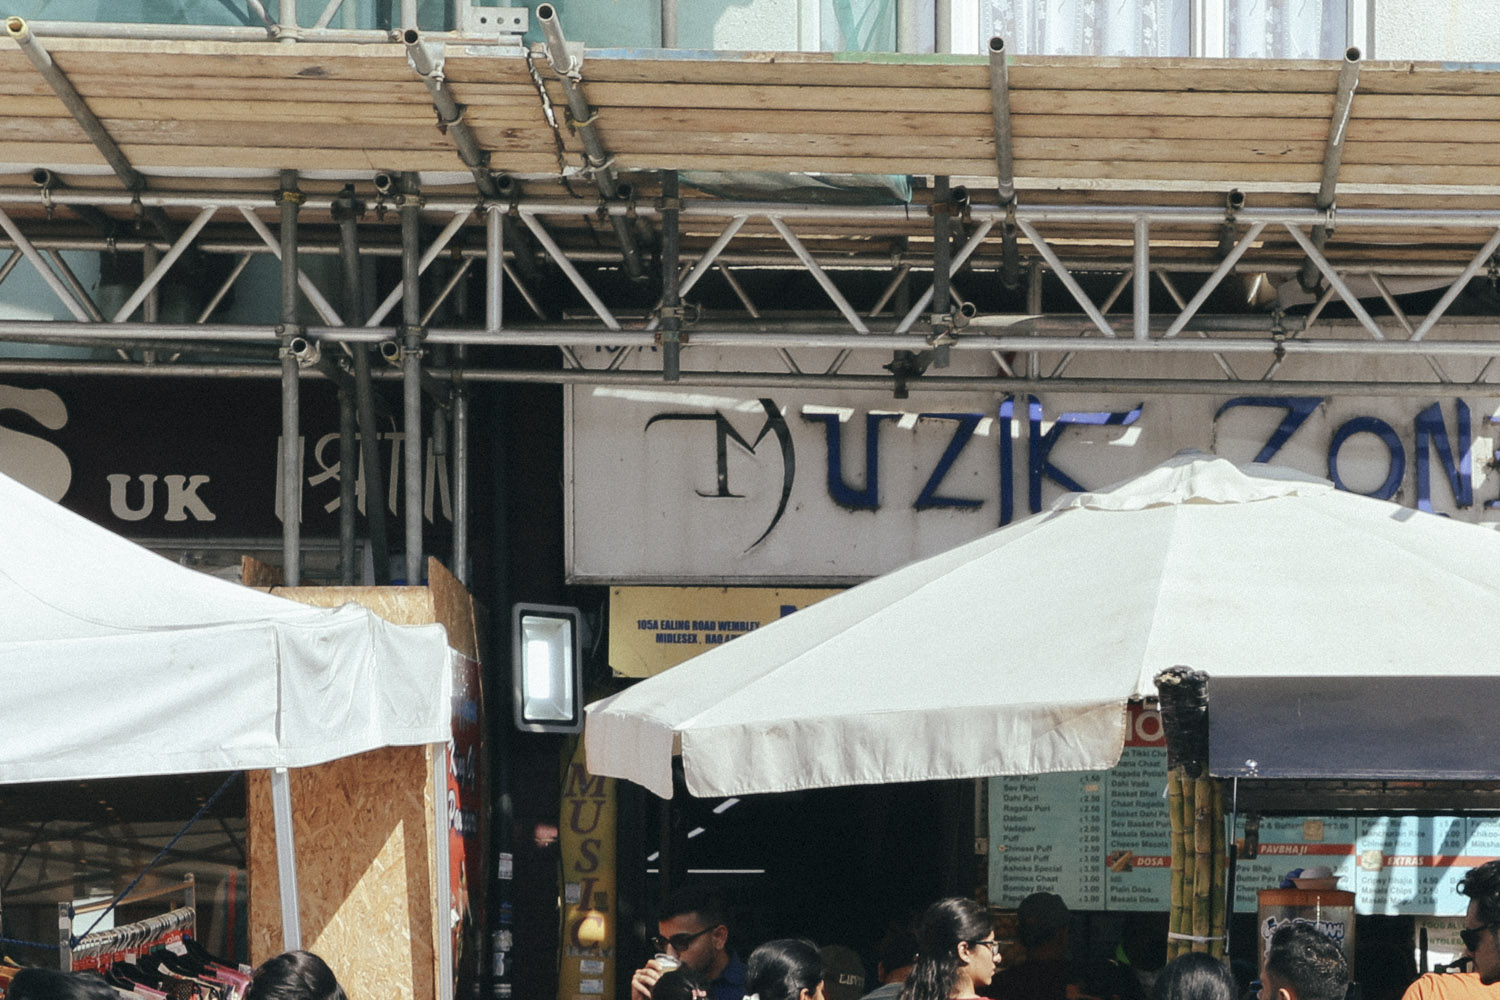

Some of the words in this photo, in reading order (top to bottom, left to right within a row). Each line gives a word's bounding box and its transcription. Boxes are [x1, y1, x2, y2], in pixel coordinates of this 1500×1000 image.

[107, 473, 216, 522] UK
[637, 620, 659, 630] 105A
[660, 620, 691, 631] EALING
[692, 621, 717, 631] ROAD
[1137, 857, 1165, 866] DOSA
[1387, 857, 1424, 866] EXTRAS
